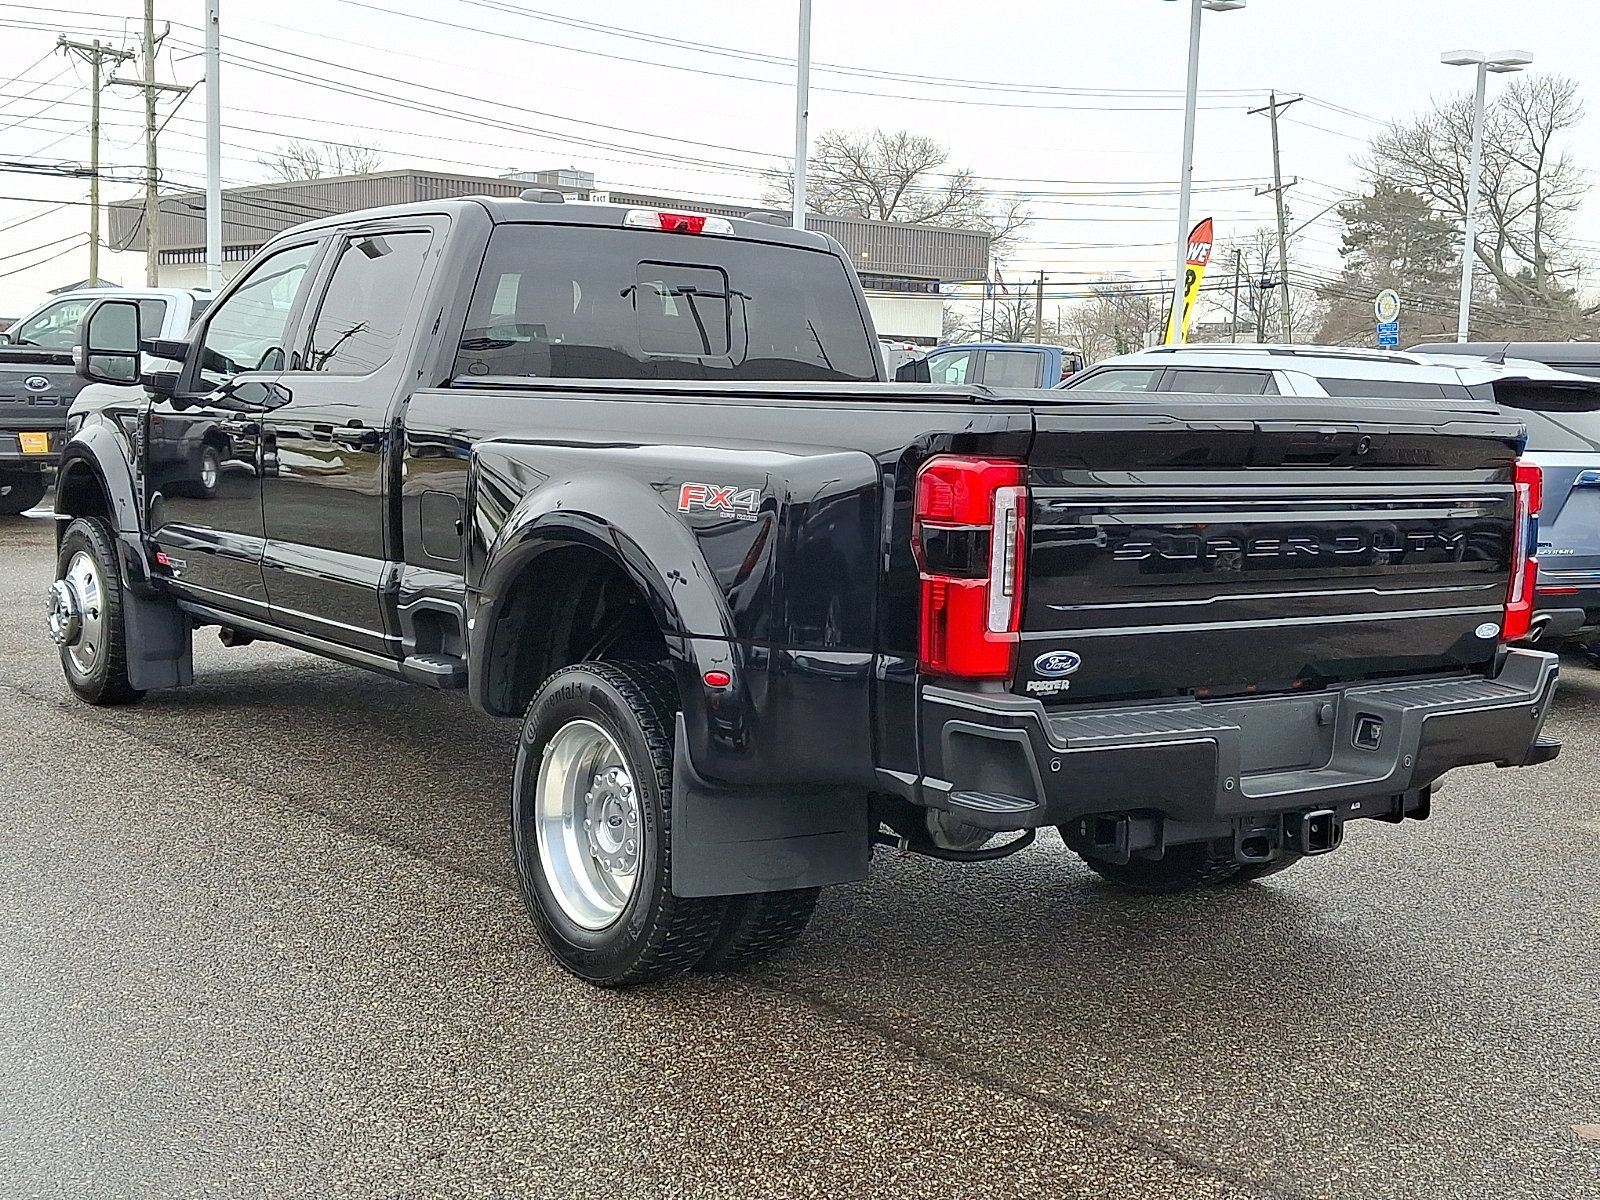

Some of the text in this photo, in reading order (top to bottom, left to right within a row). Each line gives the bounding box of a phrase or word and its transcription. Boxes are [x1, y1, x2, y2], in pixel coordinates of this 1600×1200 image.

[1186, 242, 1211, 263] WE
[677, 481, 761, 515] FX4
[1112, 530, 1465, 561] SUPER DUTY
[1026, 680, 1070, 692] PORTER
